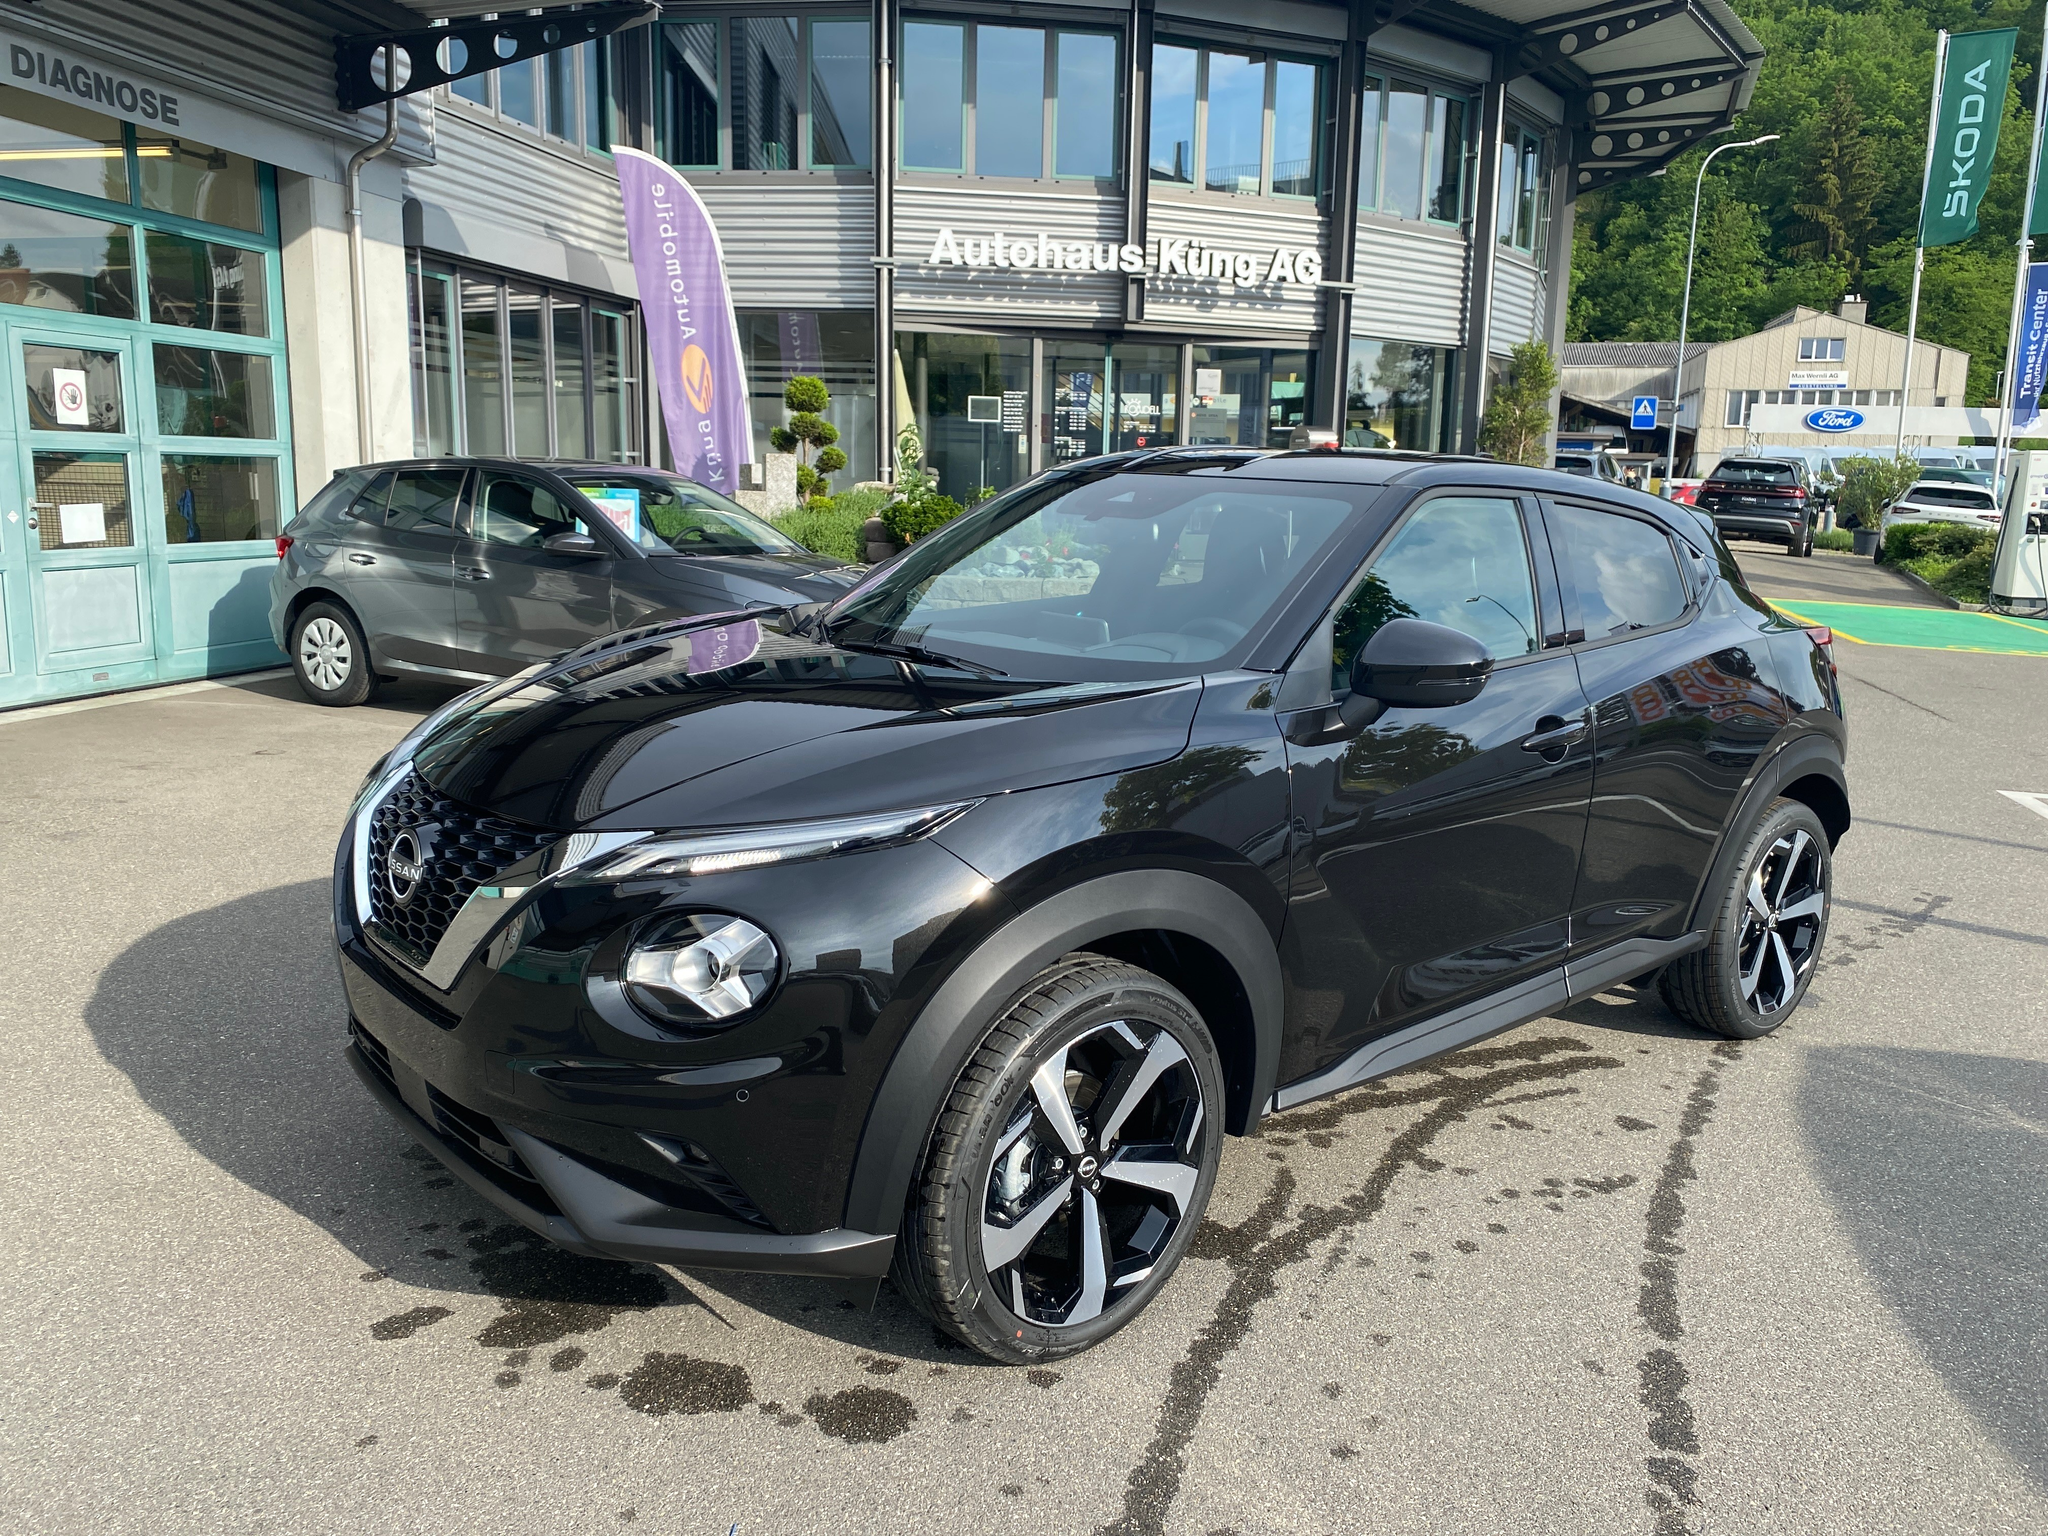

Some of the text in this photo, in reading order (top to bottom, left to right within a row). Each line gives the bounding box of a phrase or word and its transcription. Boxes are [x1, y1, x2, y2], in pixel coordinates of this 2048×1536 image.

[10, 43, 179, 126] DIAGNOSE
[929, 228, 1323, 288] Autohaus Küng AG
[2019, 288, 2048, 399] Transit Center
[1818, 409, 1855, 427] Ford
[391, 858, 420, 880] SSAN
